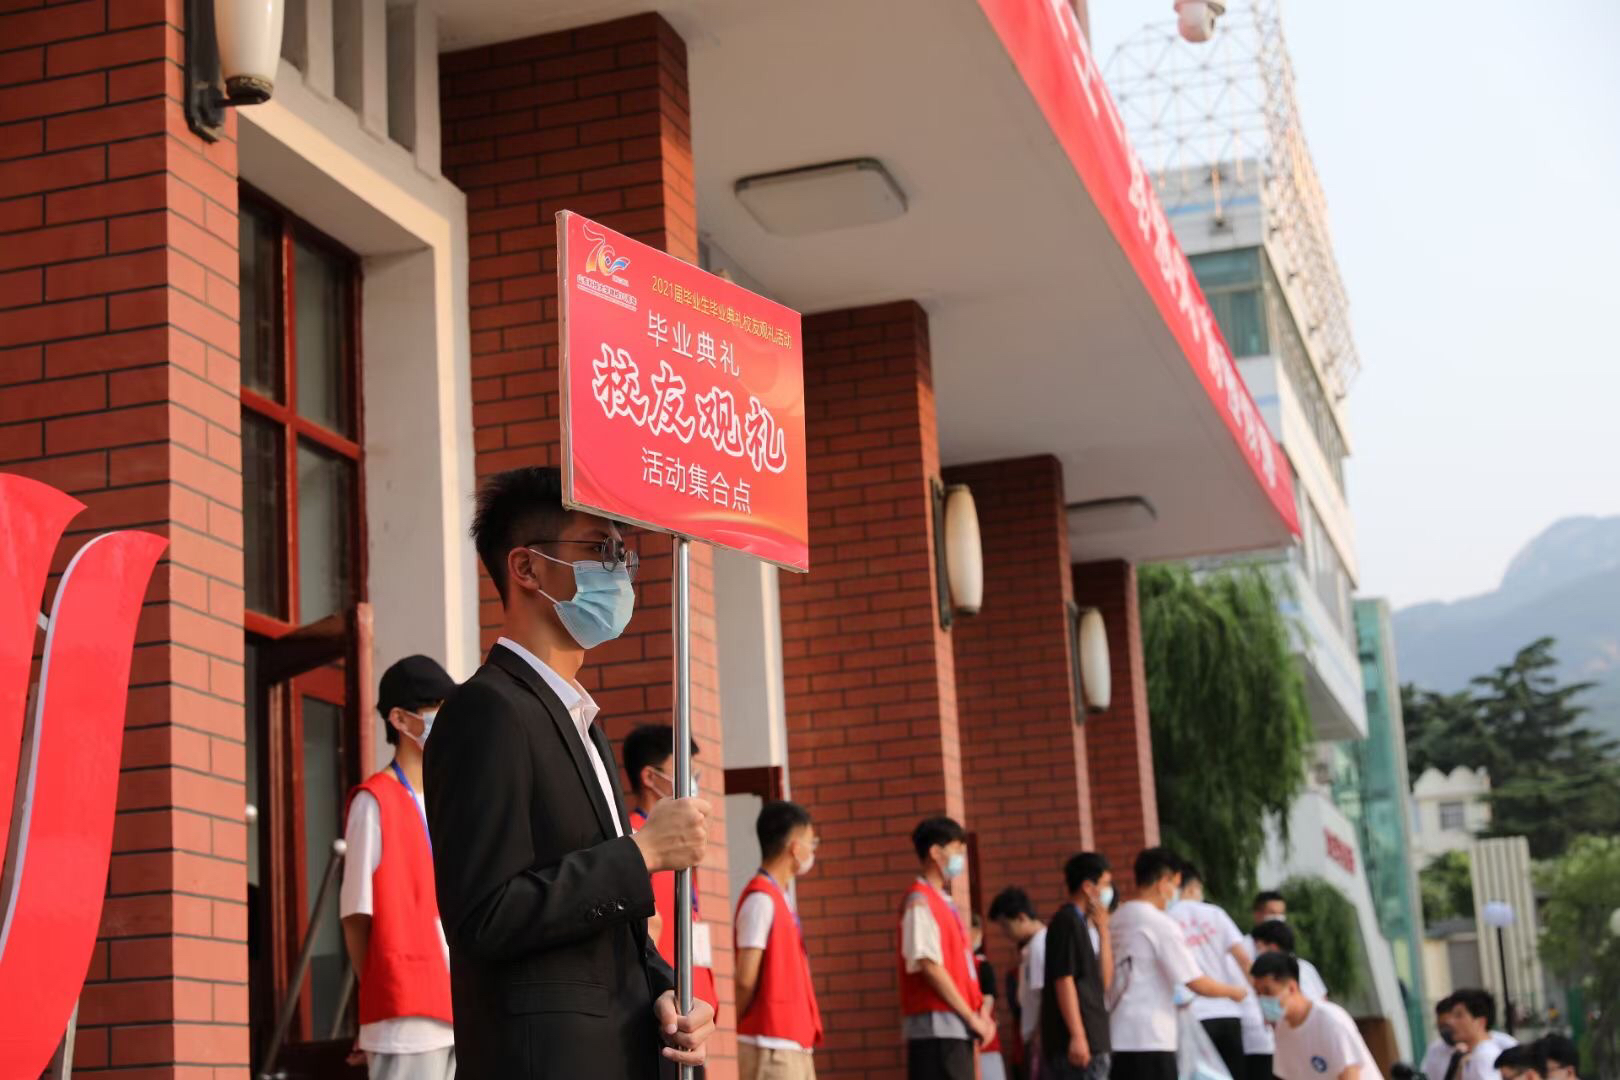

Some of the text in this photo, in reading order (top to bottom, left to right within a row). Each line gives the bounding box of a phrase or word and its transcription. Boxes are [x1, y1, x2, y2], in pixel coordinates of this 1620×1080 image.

[647, 310, 740, 377] 毕业典礼
[651, 275, 792, 350] 2021届毕业生毕业典礼校友观礼活动
[592, 343, 787, 473] 校友观礼
[641, 447, 752, 516] 活动集合点
